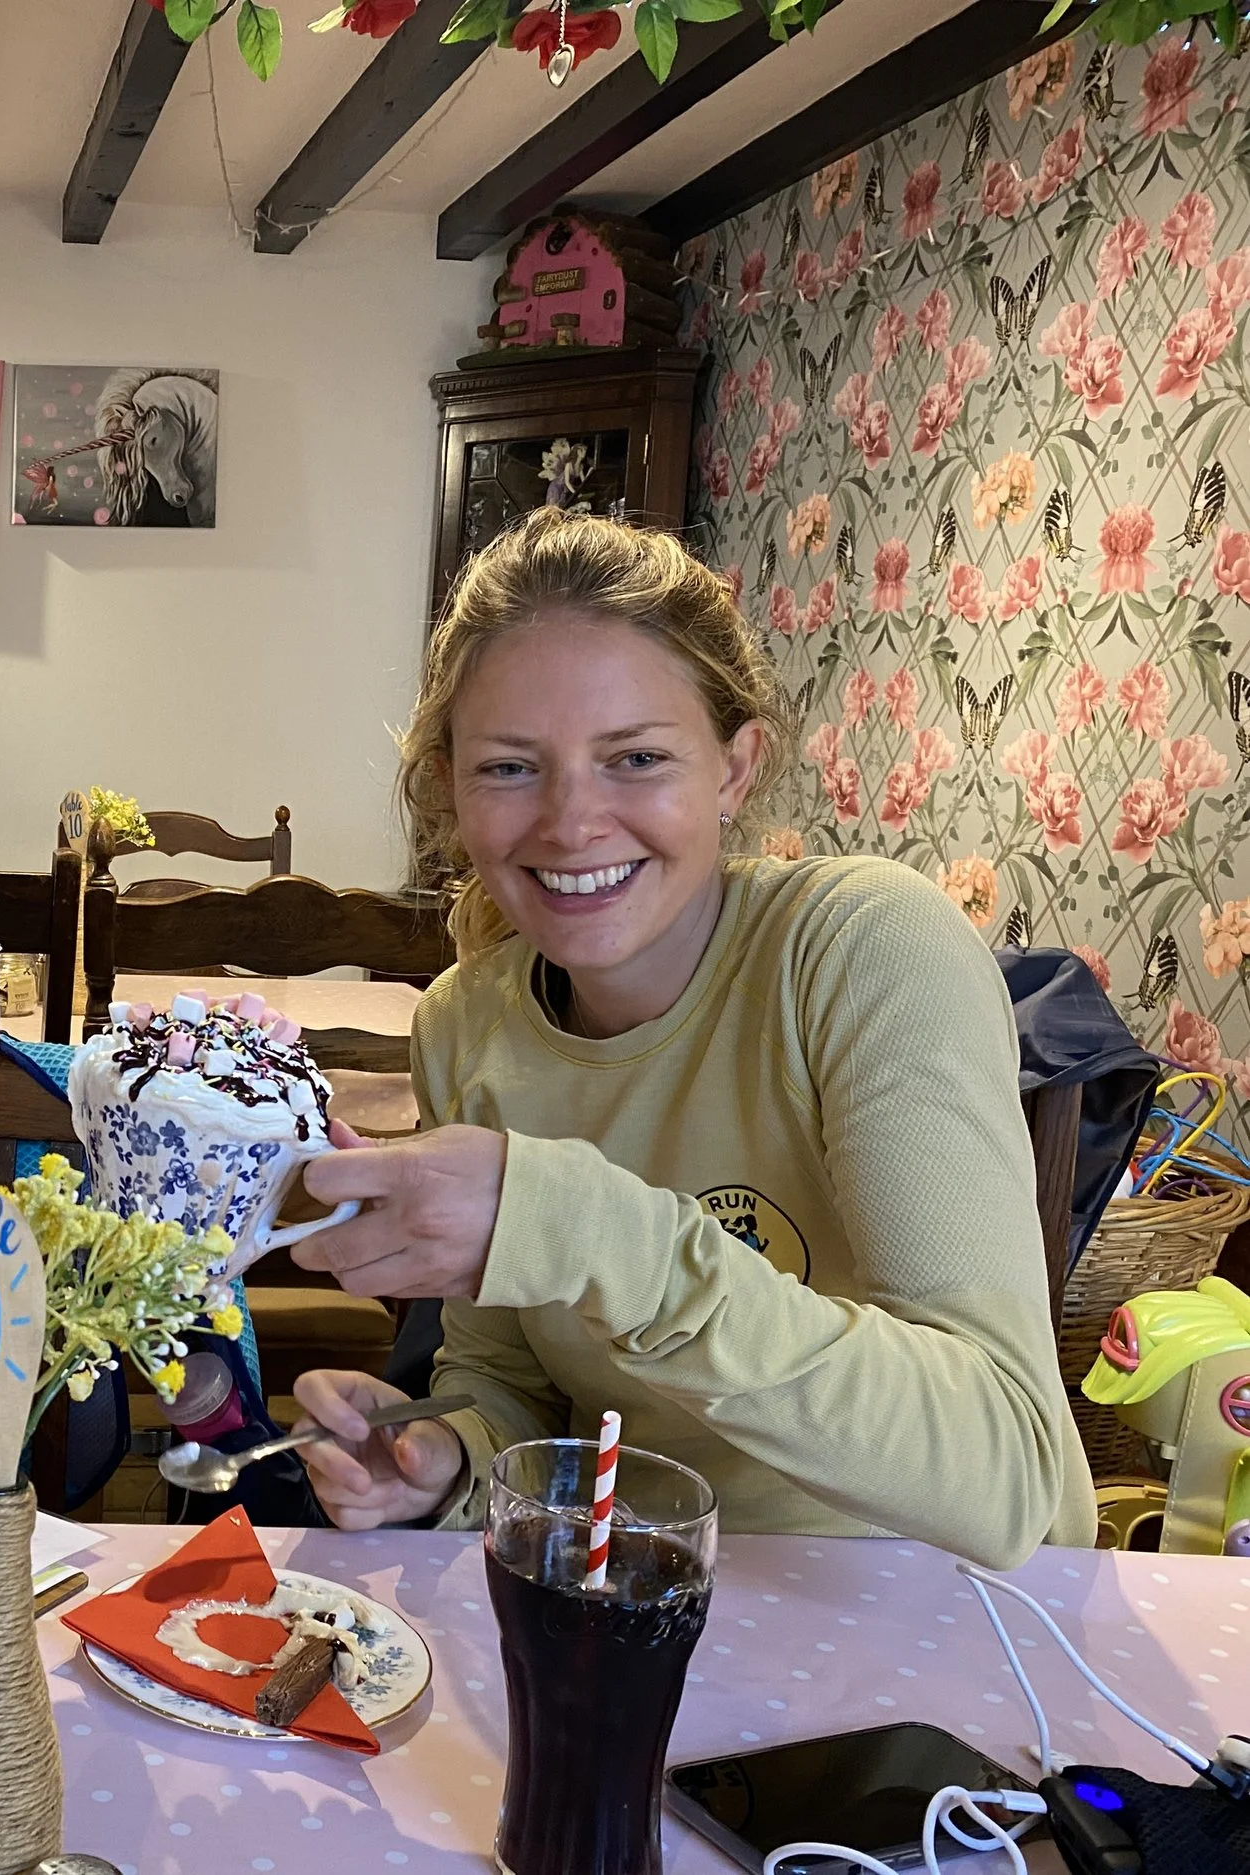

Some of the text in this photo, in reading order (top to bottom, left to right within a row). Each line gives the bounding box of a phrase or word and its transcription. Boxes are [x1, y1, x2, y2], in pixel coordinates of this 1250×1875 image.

[537, 270, 579, 283] FAIRYDUST
[535, 279, 576, 292] EMPORIUM
[69, 813, 83, 839] 10
[707, 1193, 757, 1212] RUN
